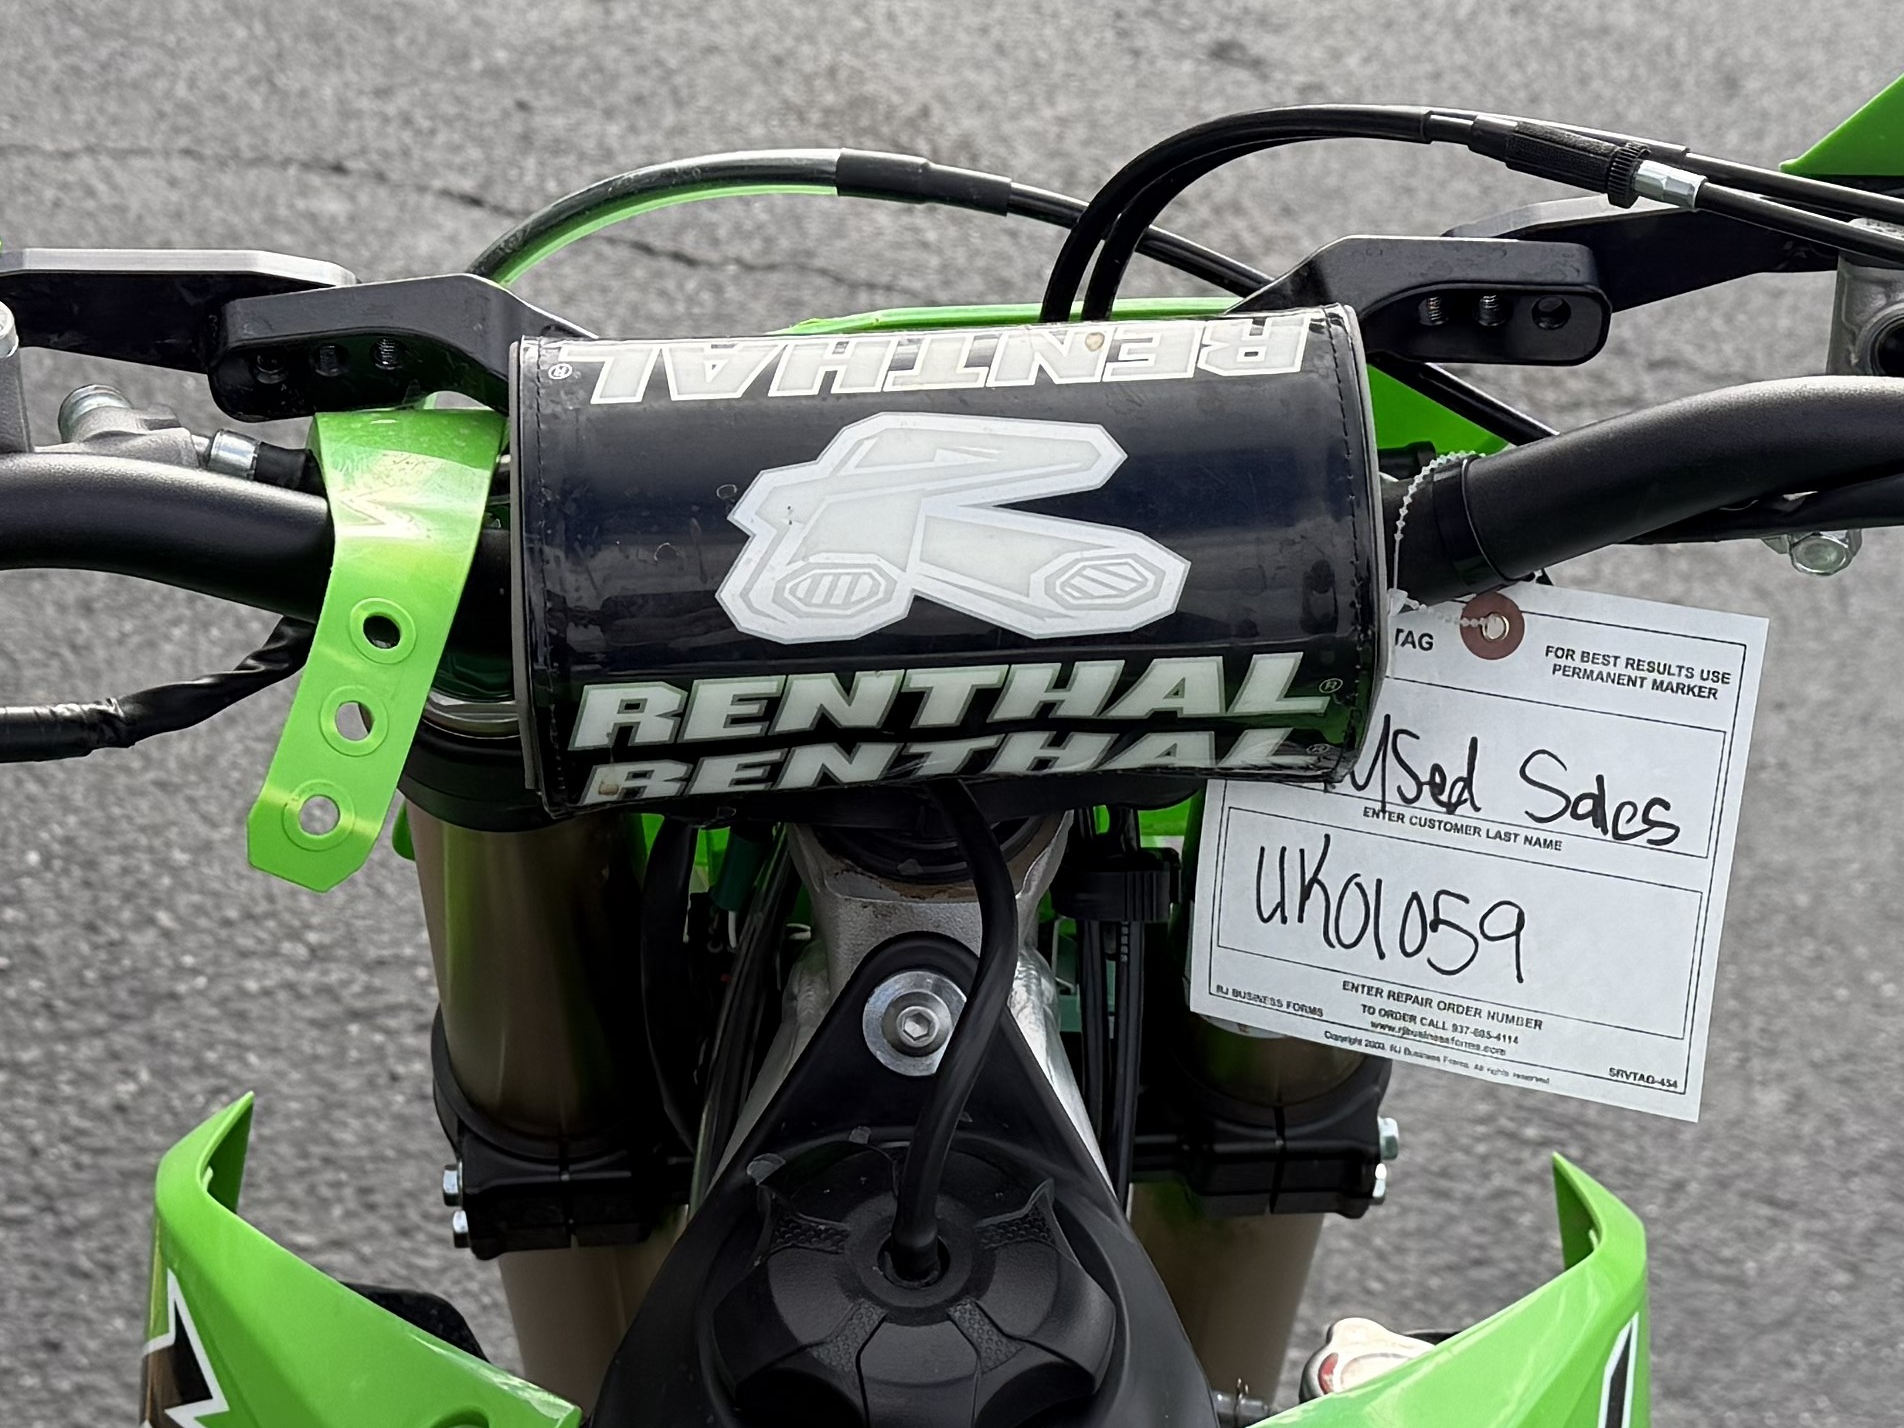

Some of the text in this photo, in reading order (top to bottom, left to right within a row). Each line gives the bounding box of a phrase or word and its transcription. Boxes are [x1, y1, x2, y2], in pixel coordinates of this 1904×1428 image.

[555, 312, 1314, 405] RENTHAL
[1545, 645, 1732, 685] FOR BEST RESULTS USE
[1552, 663, 1718, 700] PERMANENT MARKER
[568, 652, 1336, 752] RENTHAL
[579, 727, 1318, 805] RENTHAL
[1362, 806, 1563, 851] ENTER CUSTOMER LAST NAME
[1286, 1001, 1324, 1018] FORMS
[1342, 980, 1543, 1031] ENTER REPAIR ORDER NUMBER
[1361, 1004, 1376, 1016] TO
[1378, 1008, 1417, 1024] ORDER
[1420, 1016, 1448, 1030] CALL
